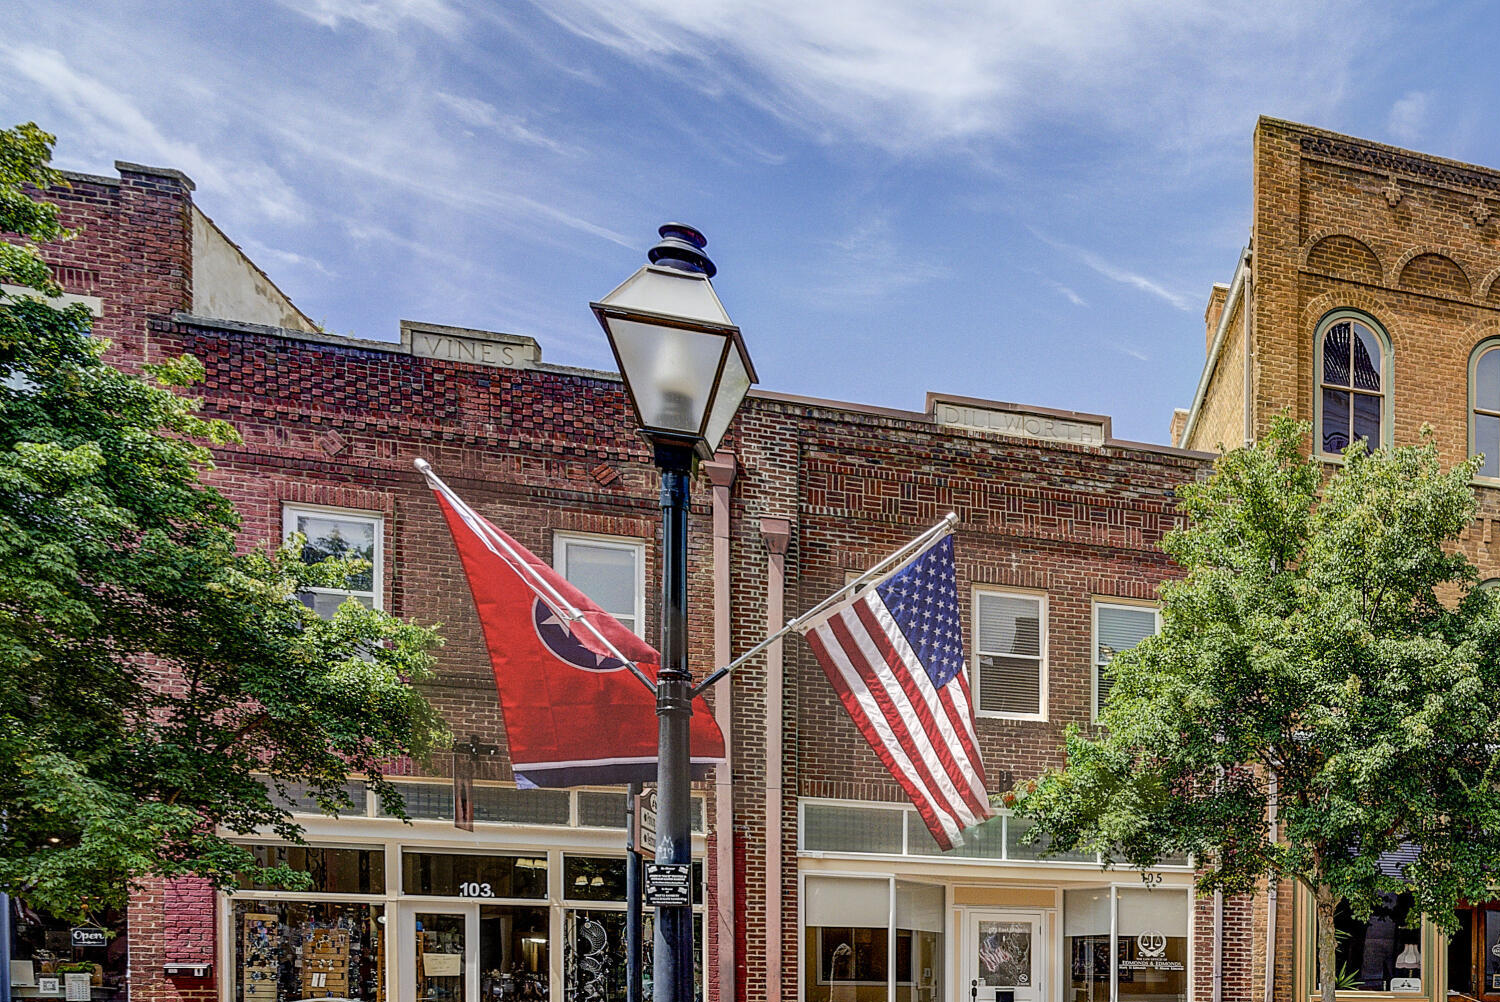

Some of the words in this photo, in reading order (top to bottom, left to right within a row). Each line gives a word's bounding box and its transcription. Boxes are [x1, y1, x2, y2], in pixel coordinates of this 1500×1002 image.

[1141, 872, 1162, 883] 105
[459, 882, 492, 897] 103
[73, 930, 105, 941] Open
